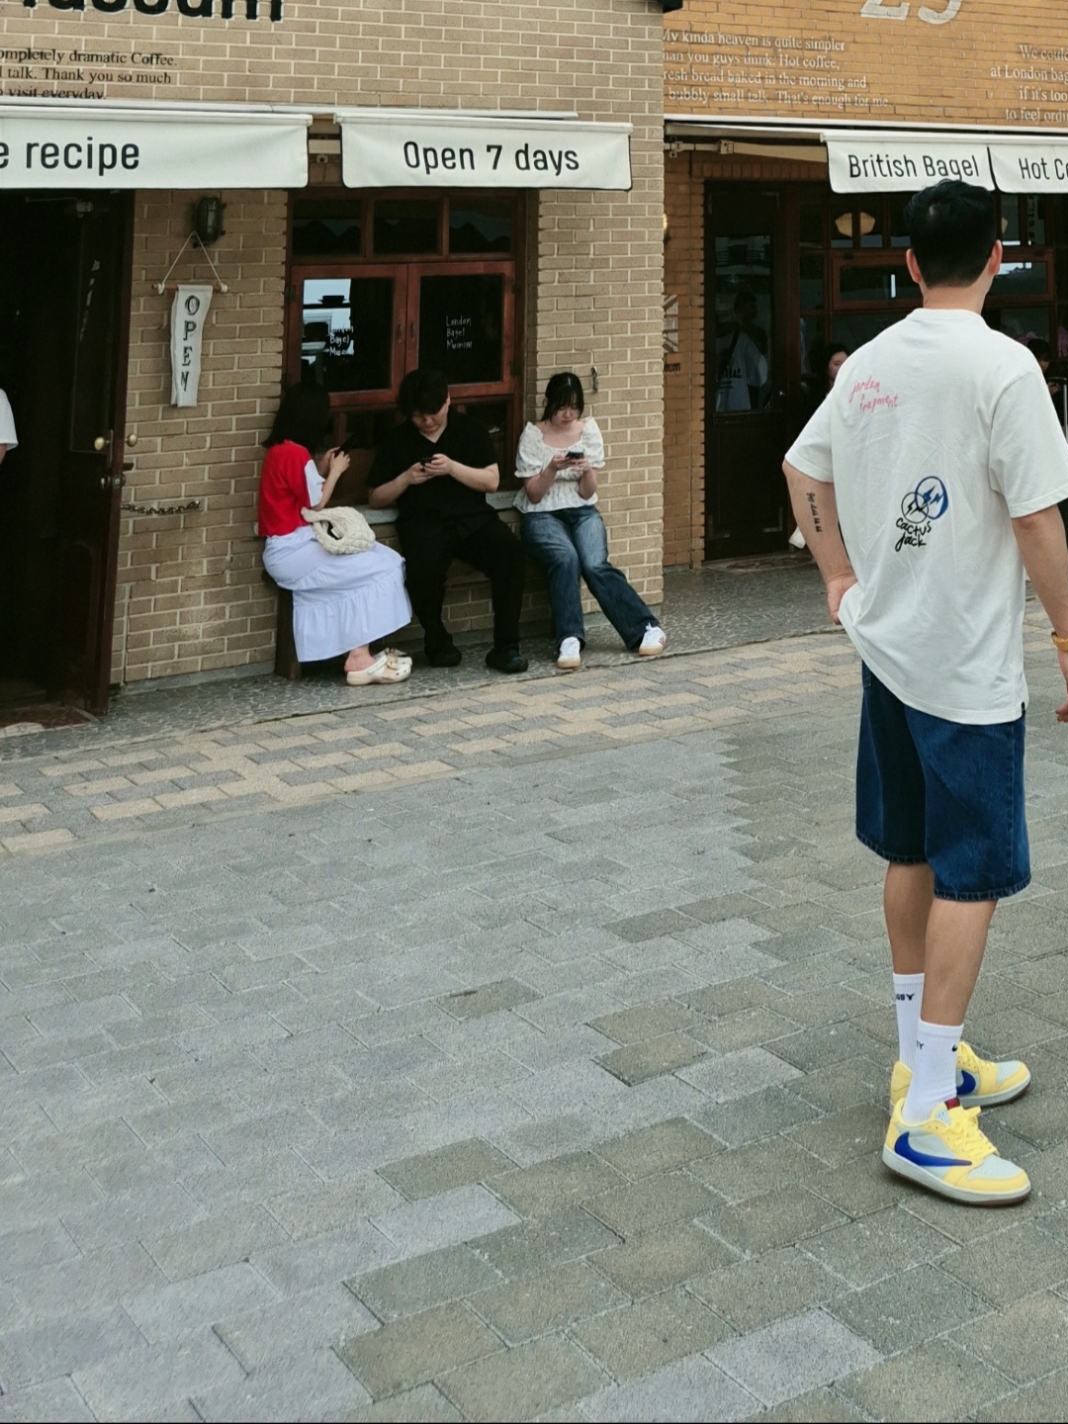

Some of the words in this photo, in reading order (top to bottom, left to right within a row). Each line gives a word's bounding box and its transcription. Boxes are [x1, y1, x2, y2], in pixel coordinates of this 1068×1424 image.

[682, 29, 715, 44] kinda
[718, 31, 759, 46] heaven
[762, 35, 772, 47] is
[774, 36, 803, 50] quite
[805, 37, 846, 53] simpler
[0, 48, 65, 65] ompletely
[69, 50, 128, 64] dramatic
[131, 51, 178, 66] Coffee.
[687, 52, 710, 65] you
[712, 53, 740, 68] guys
[743, 51, 775, 66] think.
[779, 53, 801, 67] Hot
[1019, 45, 1038, 59] We
[8, 66, 37, 79] talk.
[42, 67, 84, 81] Thank
[89, 71, 113, 84] you
[117, 73, 132, 83] so
[136, 71, 172, 84] much
[663, 68, 688, 81] resh
[691, 69, 724, 83] bread
[727, 70, 762, 84] baked
[765, 71, 776, 85] in
[779, 72, 796, 86] the
[799, 75, 845, 91] morning
[847, 75, 867, 89] and
[990, 66, 1002, 77] at
[1004, 64, 1048, 80] London
[9, 85, 37, 97] visit
[668, 87, 710, 105] bubbly
[713, 88, 744, 102] small
[747, 89, 772, 104] talk.
[811, 93, 851, 109] enough
[854, 93, 870, 107] for
[1019, 85, 1030, 101] if
[1050, 88, 1068, 103] too
[1005, 107, 1017, 121] to
[1020, 107, 1040, 122] feel
[26, 136, 140, 177] recipe
[403, 140, 476, 175] Open
[485, 144, 503, 170] 7
[514, 143, 580, 177] days
[848, 154, 916, 178] British
[922, 154, 980, 181] Bagel
[1018, 157, 1050, 180] Hot
[179, 294, 202, 393] OPEN
[859, 393, 898, 413] fragment
